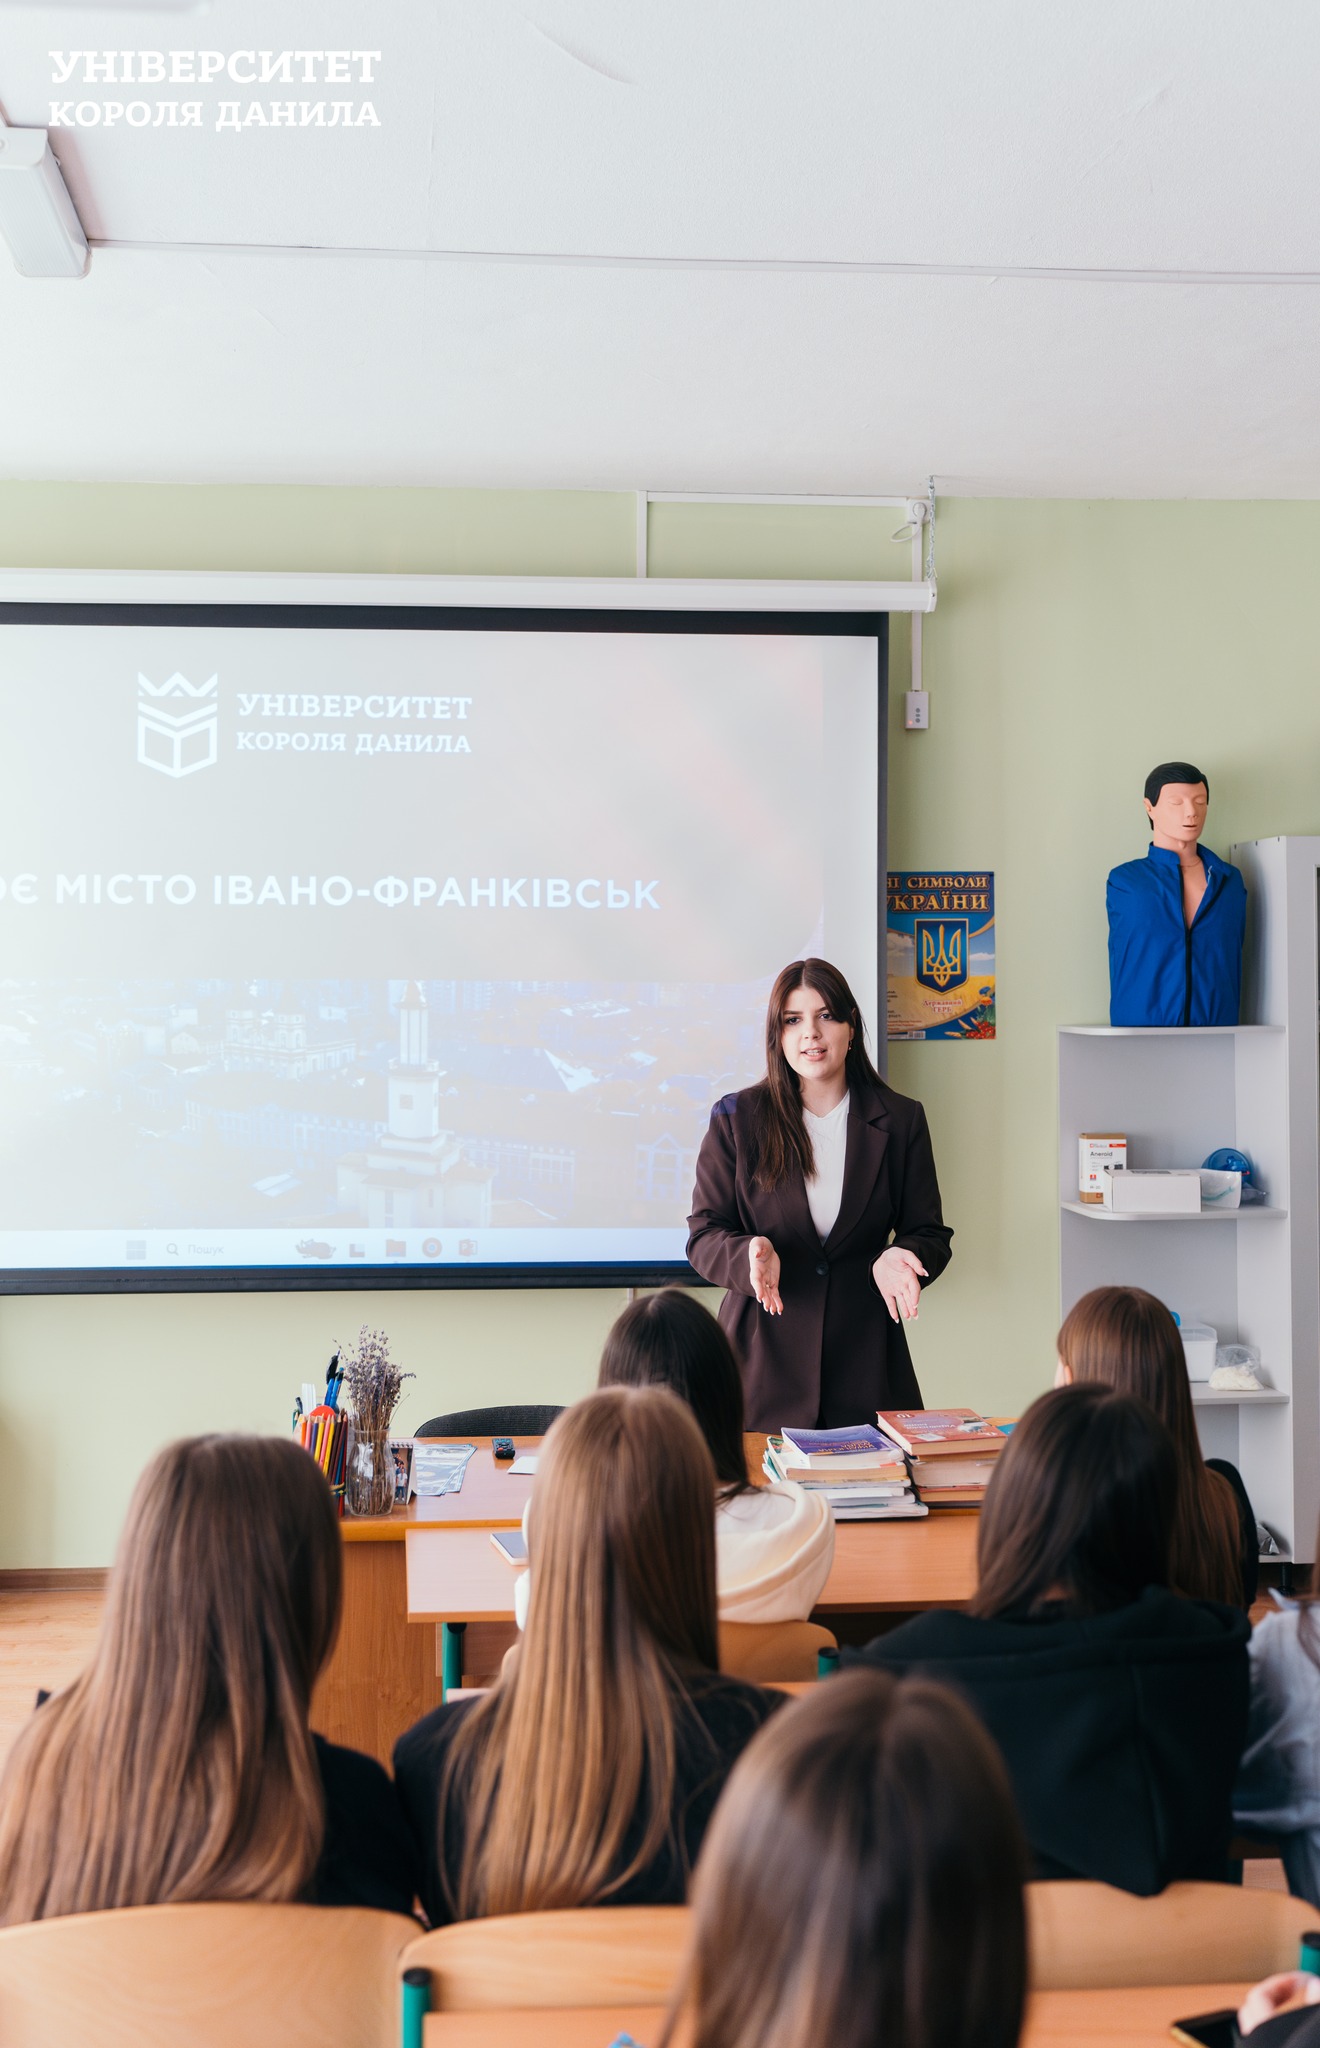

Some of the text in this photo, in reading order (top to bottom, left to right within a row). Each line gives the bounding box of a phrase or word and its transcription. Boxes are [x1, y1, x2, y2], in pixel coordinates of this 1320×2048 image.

[236, 693, 473, 720] УНІВЕРСИТЕТ
[236, 731, 473, 756] КОРОЛЯ ДАНИЛА
[0, 873, 661, 910] Є МІСТО ІВАНО-ФРАНКІВСЬК
[906, 876, 988, 889] СИМВОЛИ
[187, 1244, 225, 1256] Пошук
